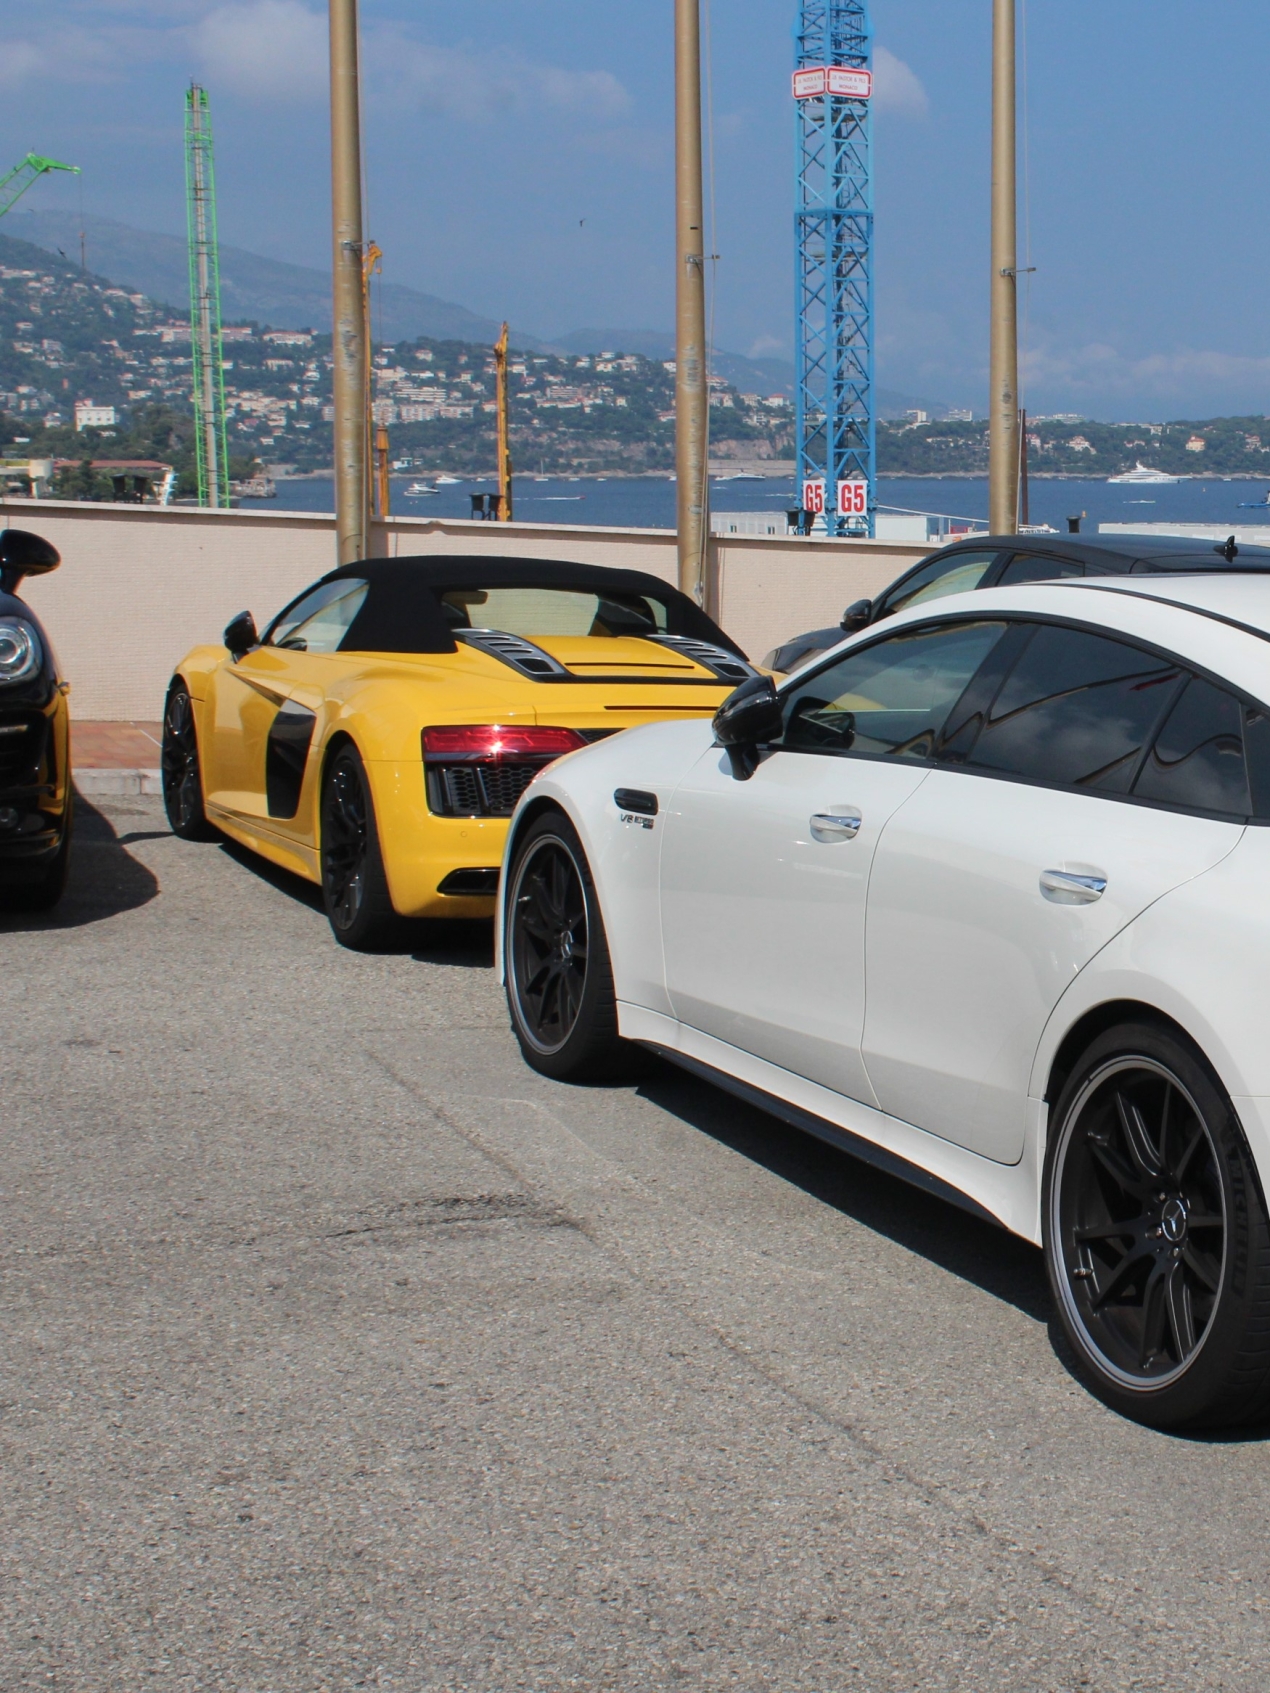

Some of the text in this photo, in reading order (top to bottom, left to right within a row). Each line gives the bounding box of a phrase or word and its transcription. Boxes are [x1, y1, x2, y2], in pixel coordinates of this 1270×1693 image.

[805, 484, 823, 513] G5
[841, 484, 864, 512] G5
[620, 813, 634, 823] V8
